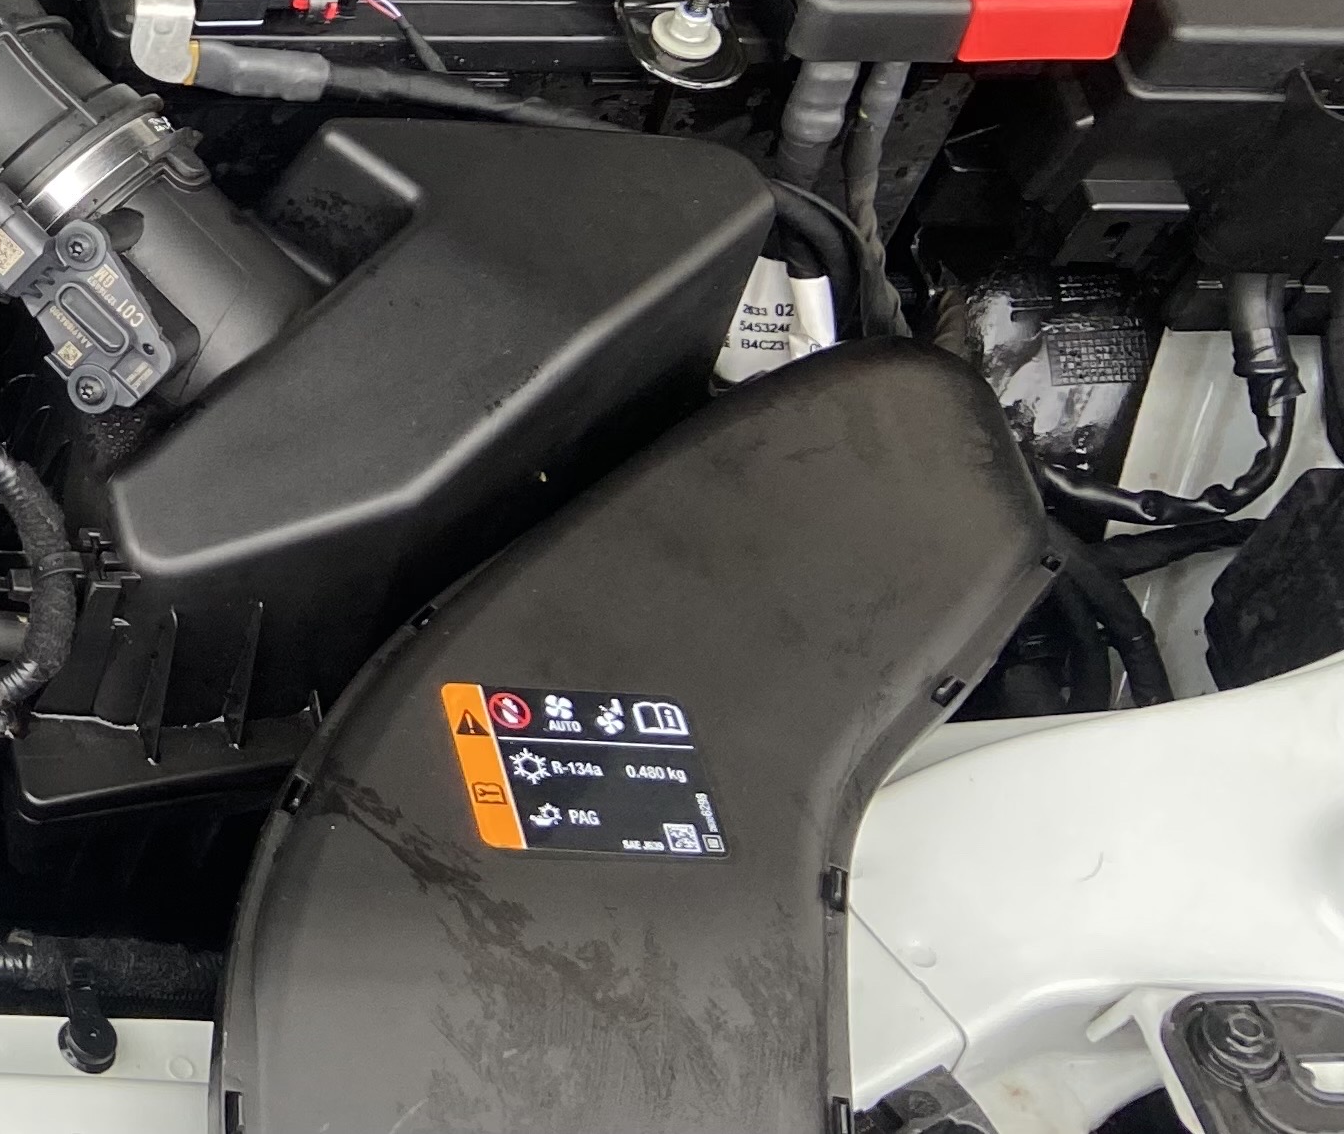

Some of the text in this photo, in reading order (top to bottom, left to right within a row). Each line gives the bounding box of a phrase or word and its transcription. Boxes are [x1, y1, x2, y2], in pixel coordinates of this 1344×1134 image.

[548, 720, 583, 733] AUTO
[551, 760, 688, 784] R-134a 0.480 kg
[568, 809, 601, 827] PAG
